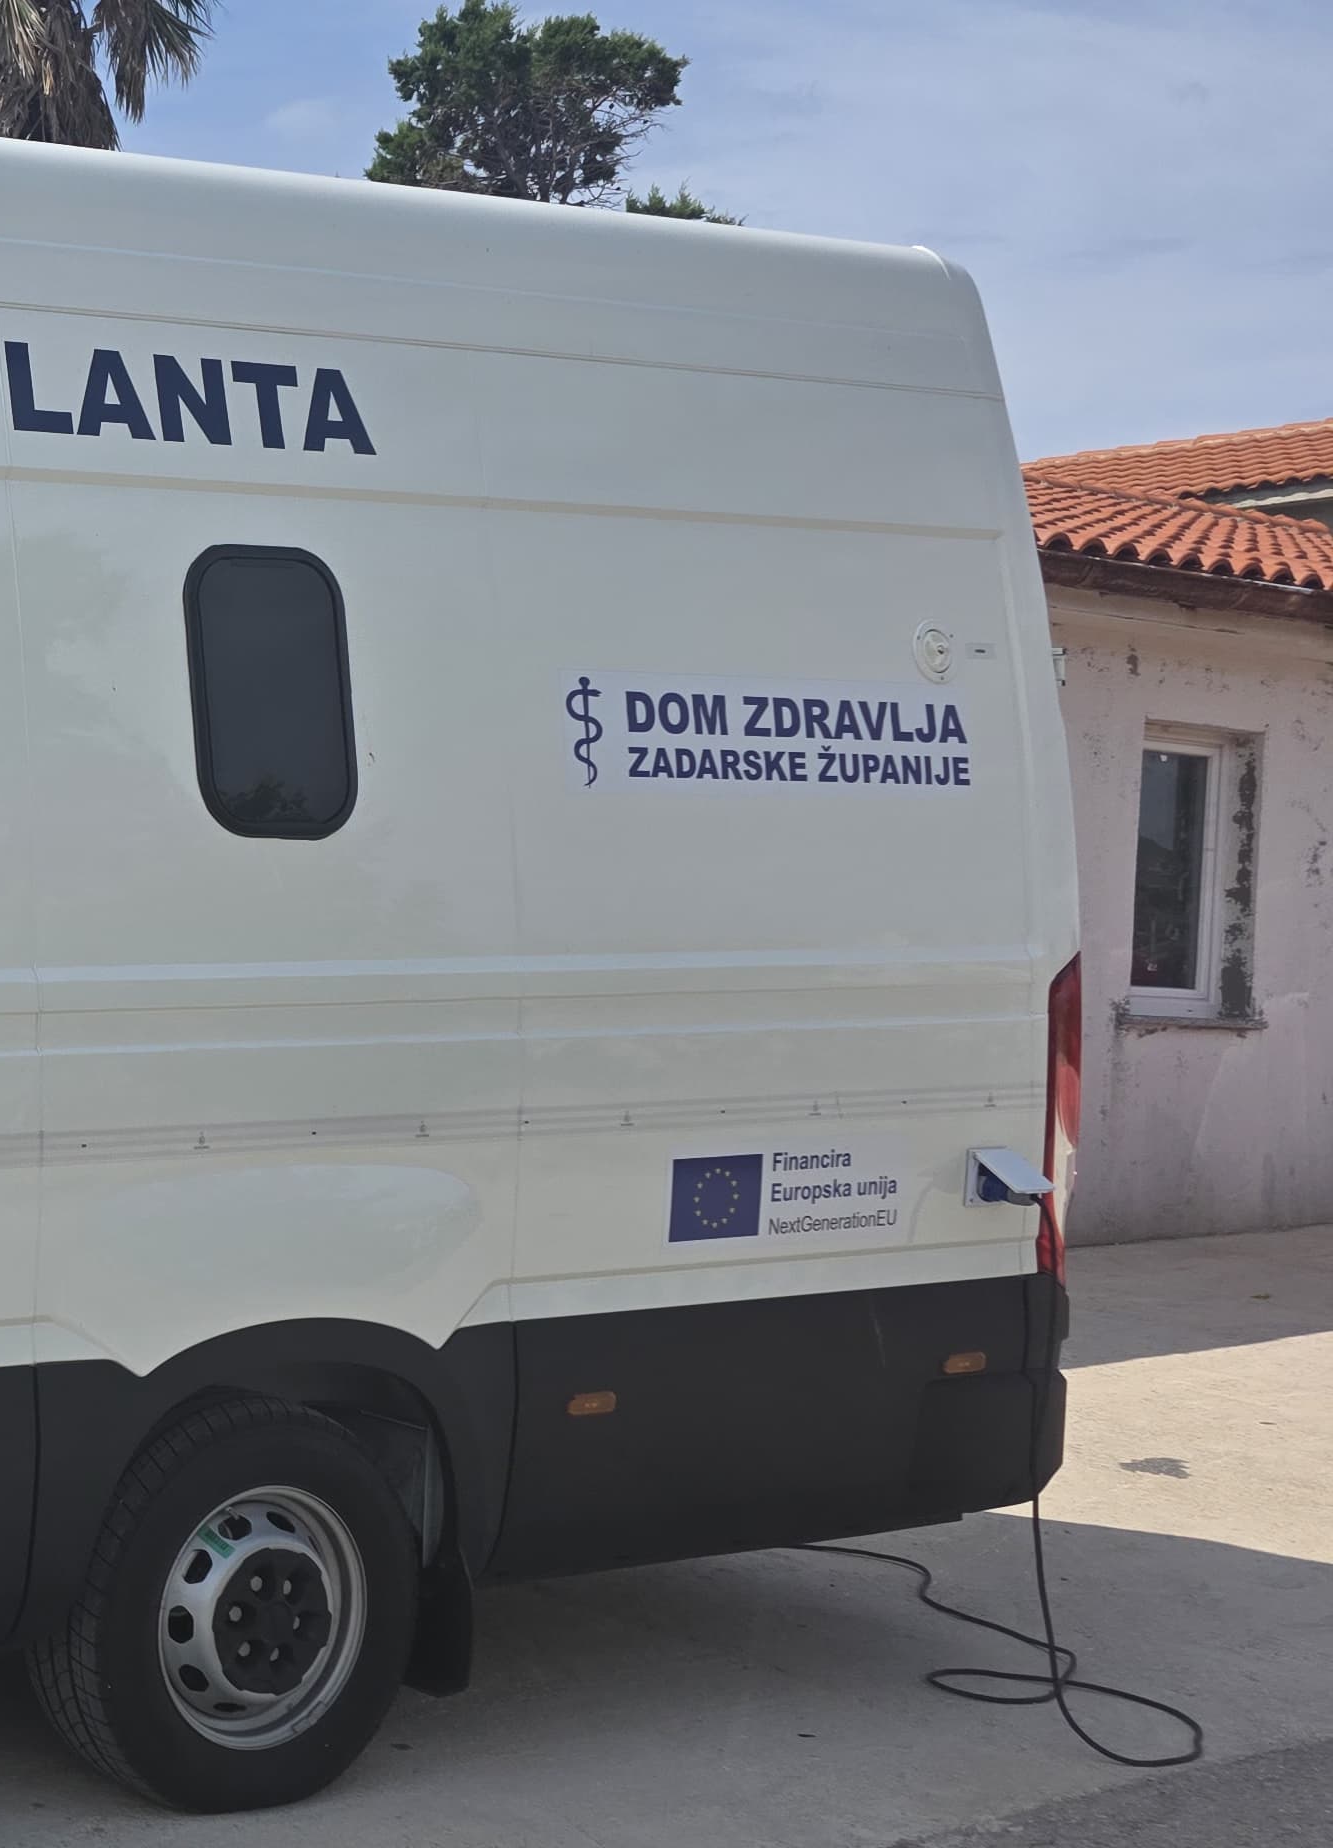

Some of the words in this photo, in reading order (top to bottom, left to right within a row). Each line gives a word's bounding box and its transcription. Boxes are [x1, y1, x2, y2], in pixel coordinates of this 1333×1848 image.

[625, 690, 729, 736] DOM
[743, 695, 968, 744] ZDRAVLJA
[627, 746, 808, 782] ZADARSKE
[817, 745, 971, 786] ŽUPANIJE
[771, 1148, 852, 1172] Financira
[770, 1178, 851, 1205] Europska
[856, 1175, 898, 1200] unija
[768, 1208, 898, 1236] NextGenerationEU
